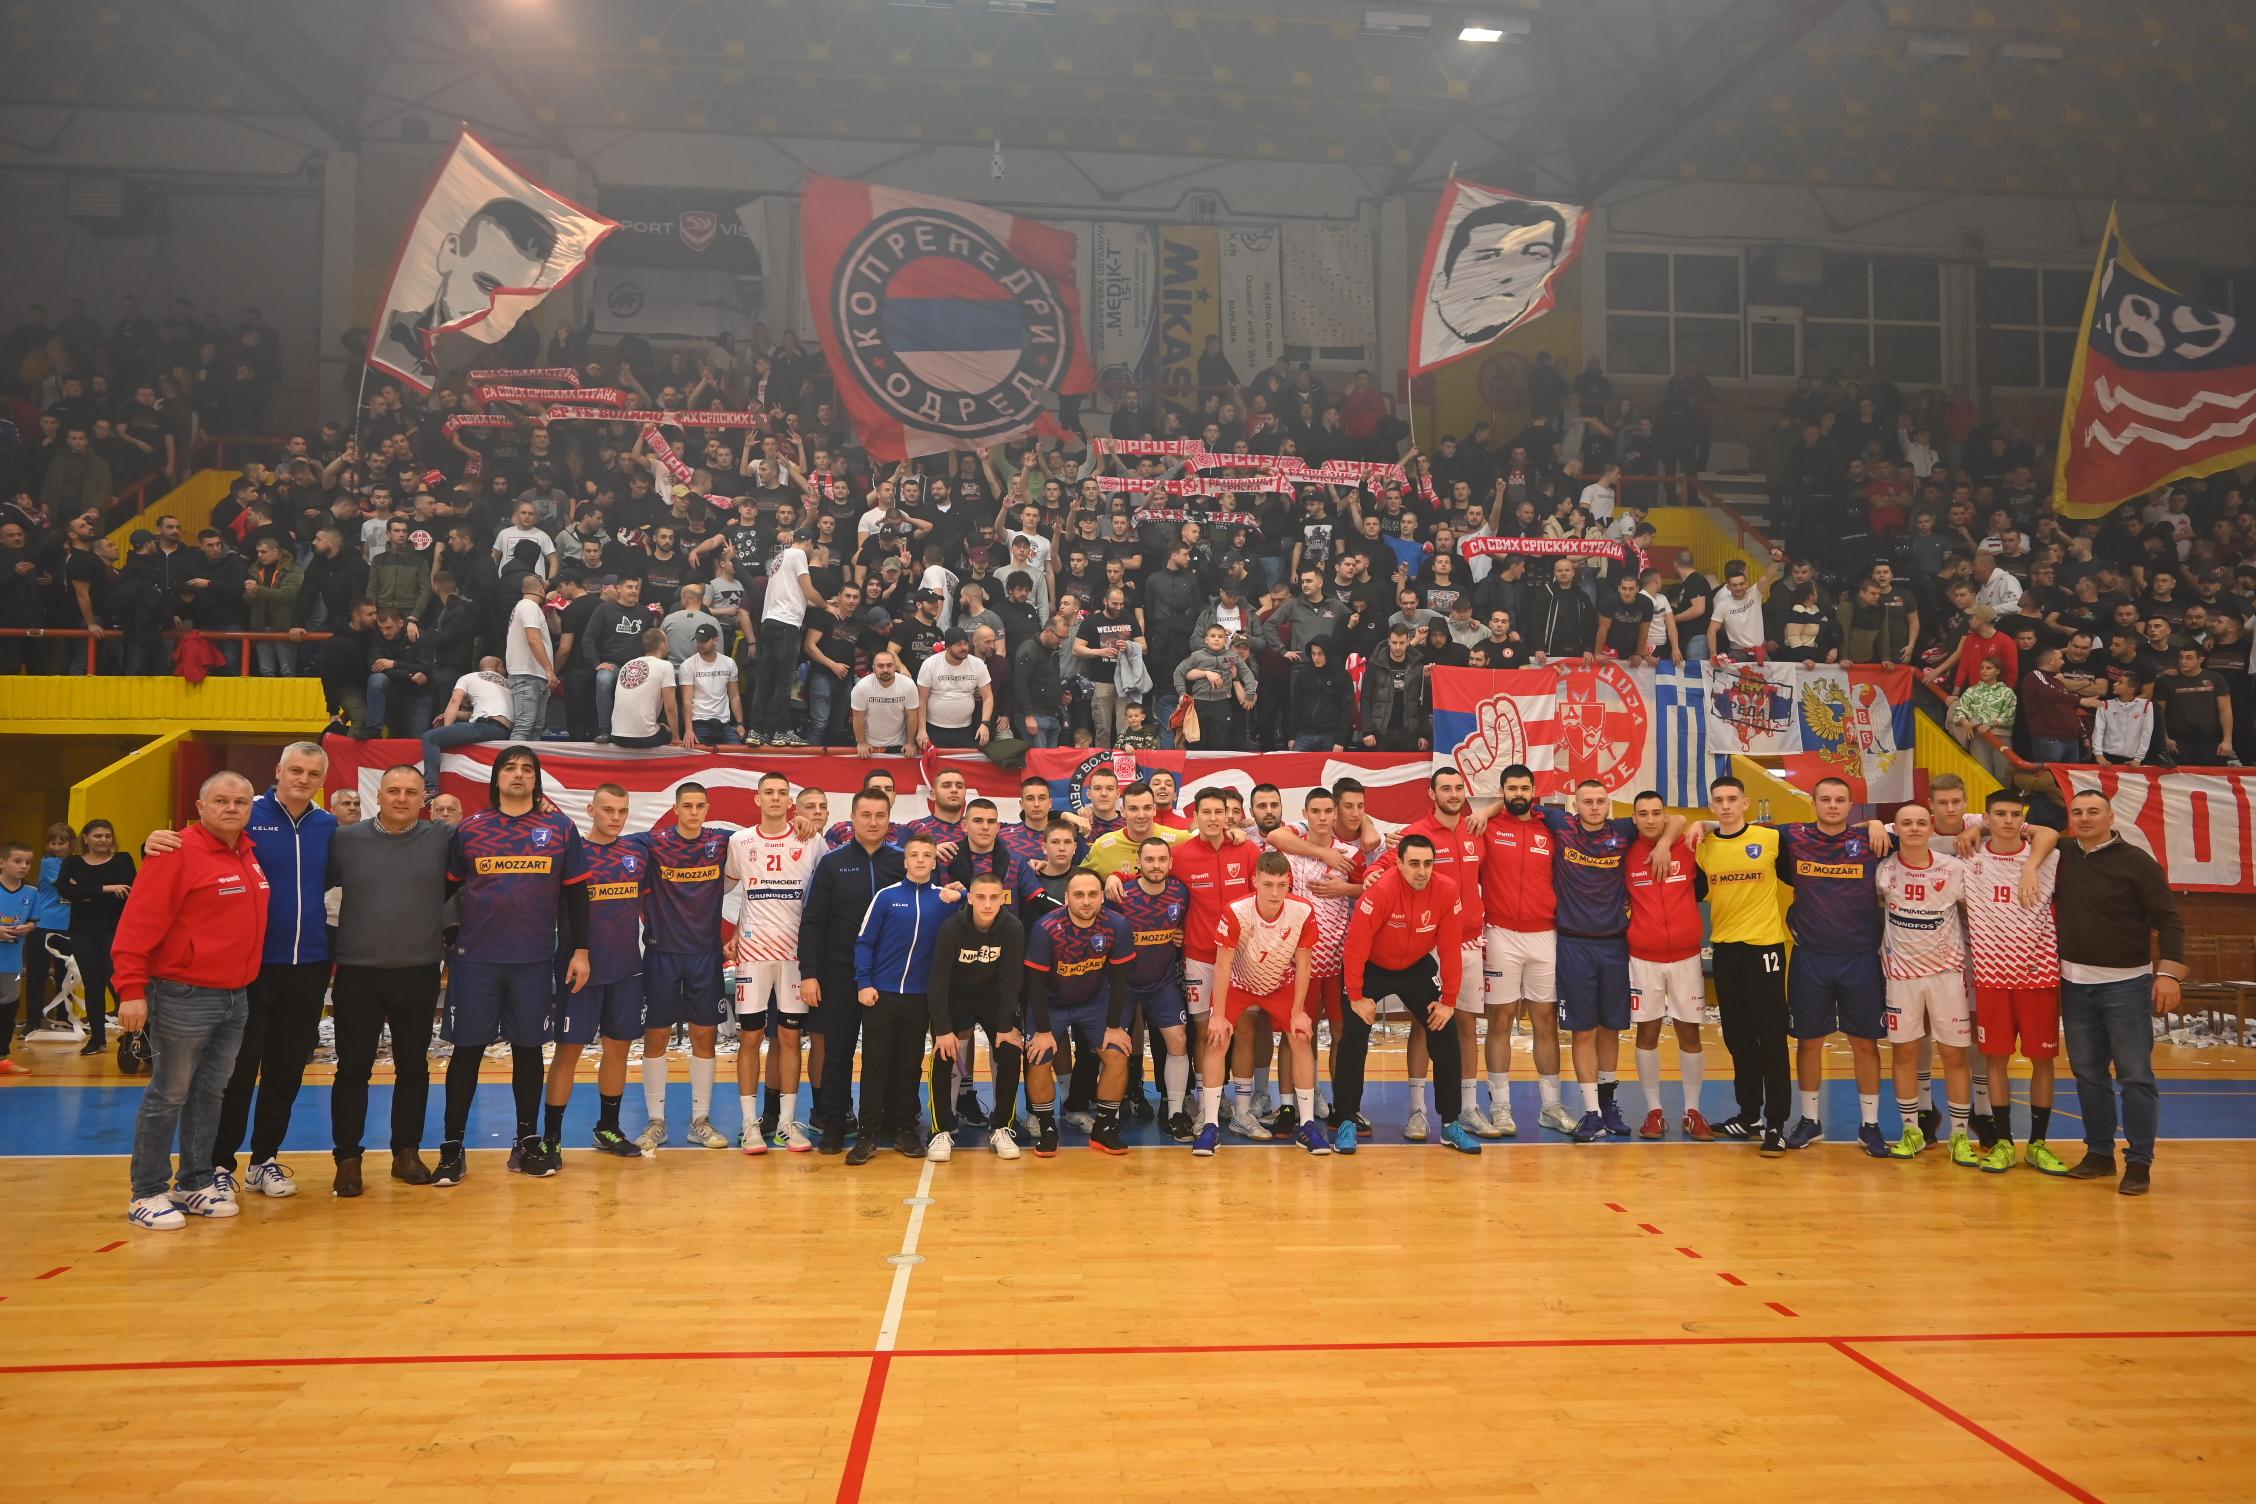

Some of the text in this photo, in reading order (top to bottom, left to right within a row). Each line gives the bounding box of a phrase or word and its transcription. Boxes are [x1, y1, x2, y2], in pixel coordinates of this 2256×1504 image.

[620, 220, 674, 235] PORT
[720, 223, 751, 237] VIS
[577, 387, 617, 402] СТРАНА
[886, 370, 1041, 423] ОДРЕД
[699, 411, 750, 425] СРПСКИХ
[1469, 539, 1624, 557] СА СВИХ СРПСКИХ СТРАНА
[1097, 625, 1132, 634] WELCOME
[495, 861, 547, 870] MOZZART
[766, 855, 782, 872] 21
[677, 868, 716, 879] MOZZART
[1720, 872, 1762, 883] MOZZART
[1813, 866, 1859, 876] MOZZART
[599, 886, 637, 897] MOZZART
[1904, 884, 1926, 902] 99
[1993, 885, 2011, 903] 19
[1898, 908, 1943, 916] PRIMOBET
[1141, 932, 1172, 943] MOZZA
[1259, 950, 1269, 964] 7
[1762, 953, 1780, 973] 12
[737, 985, 744, 1001] 21
